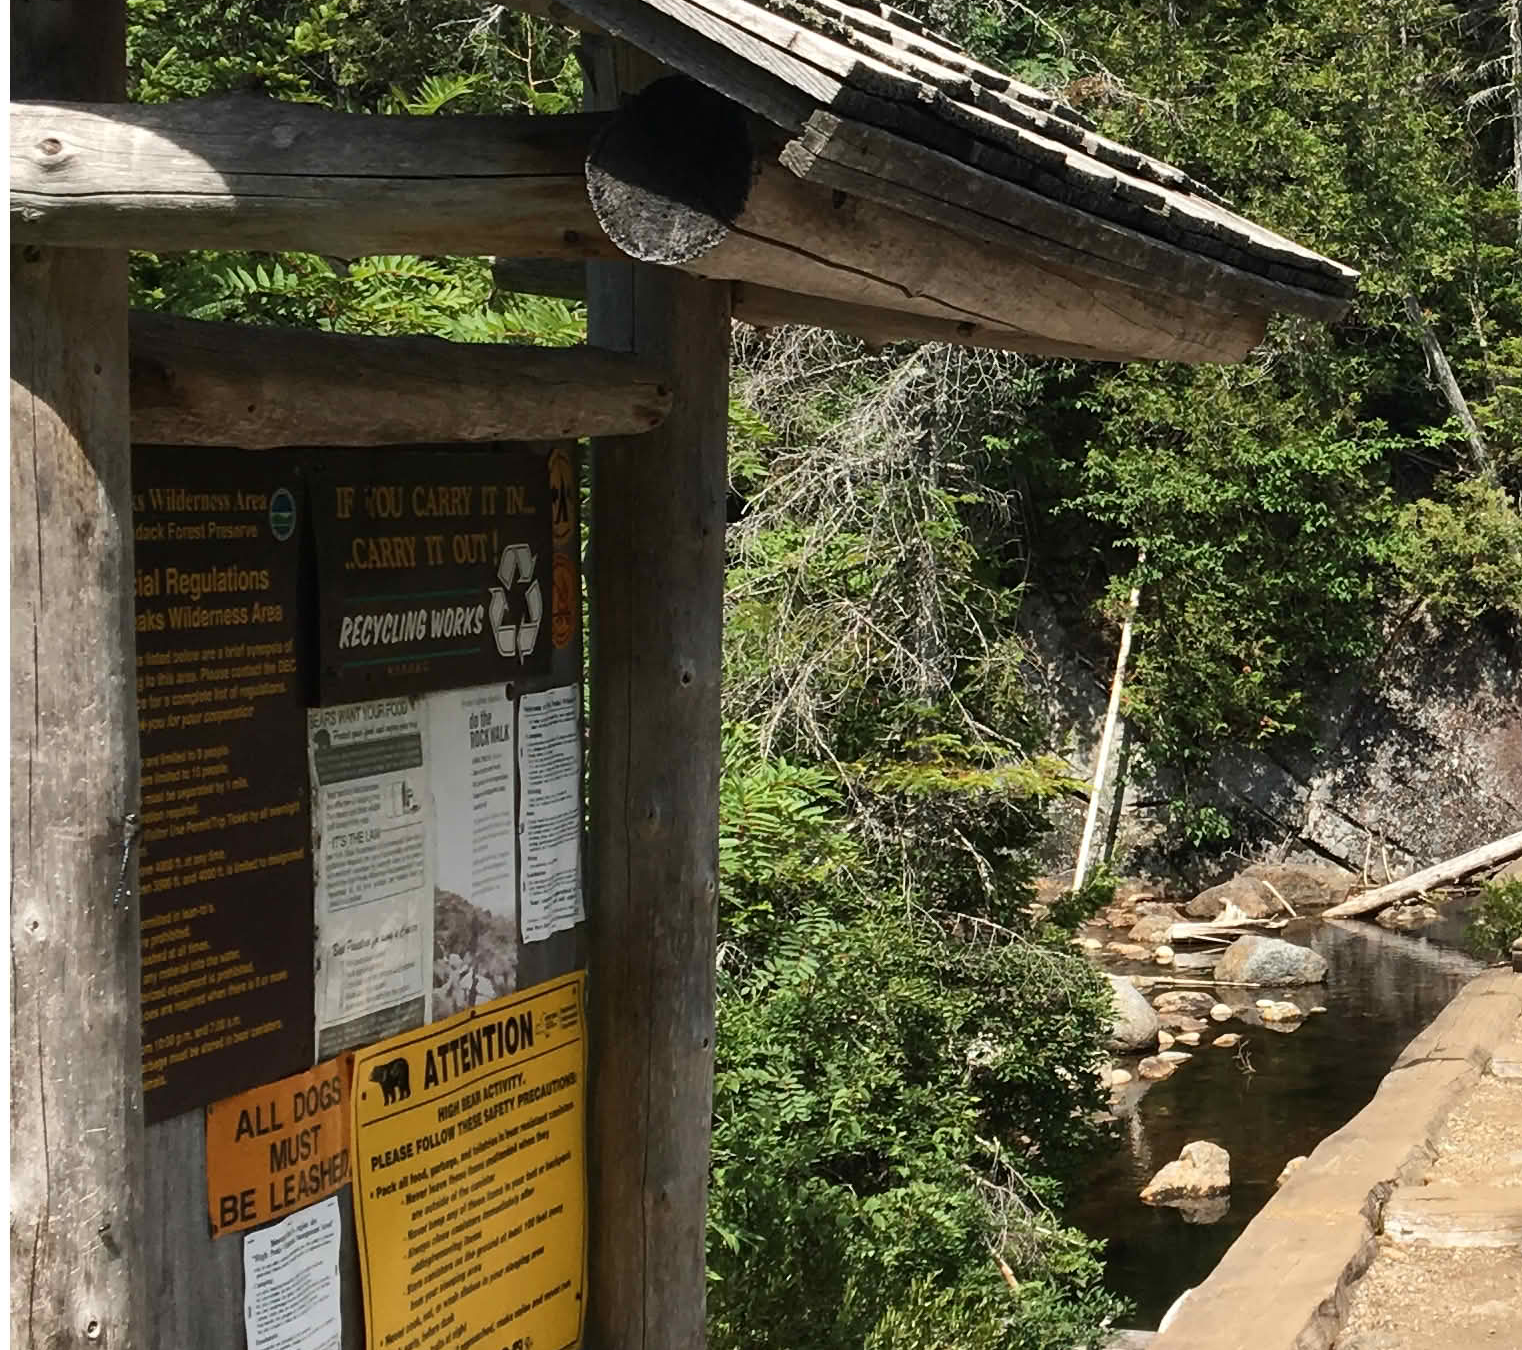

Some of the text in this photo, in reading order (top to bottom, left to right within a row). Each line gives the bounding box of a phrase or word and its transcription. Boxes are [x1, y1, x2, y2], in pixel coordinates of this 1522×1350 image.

[150, 489, 232, 513] Wilderness
[236, 489, 267, 512] Area
[336, 485, 353, 519] IF
[412, 485, 472, 517] CARRY
[480, 486, 496, 516] IT
[168, 521, 208, 538] Forest
[208, 521, 257, 538] Preserve
[424, 534, 443, 566] IT
[166, 564, 270, 601] Regulations
[168, 606, 249, 630] Wilderness
[251, 602, 282, 624] Area
[339, 603, 484, 649] RECYCLING WORKS
[480, 710, 492, 727] the
[348, 831, 364, 845] THE
[424, 1011, 534, 1090] ATTENTION
[235, 1076, 341, 1143] ALL DOGS
[438, 1073, 526, 1122] HIGH BEAR ACTIVITY.
[270, 1125, 321, 1174] MUST
[371, 1143, 413, 1172] PLEASE
[416, 1127, 456, 1154] FOLLOW
[458, 1116, 482, 1136] THESE
[484, 1100, 515, 1123] SAFETY
[220, 1188, 256, 1227] BE
